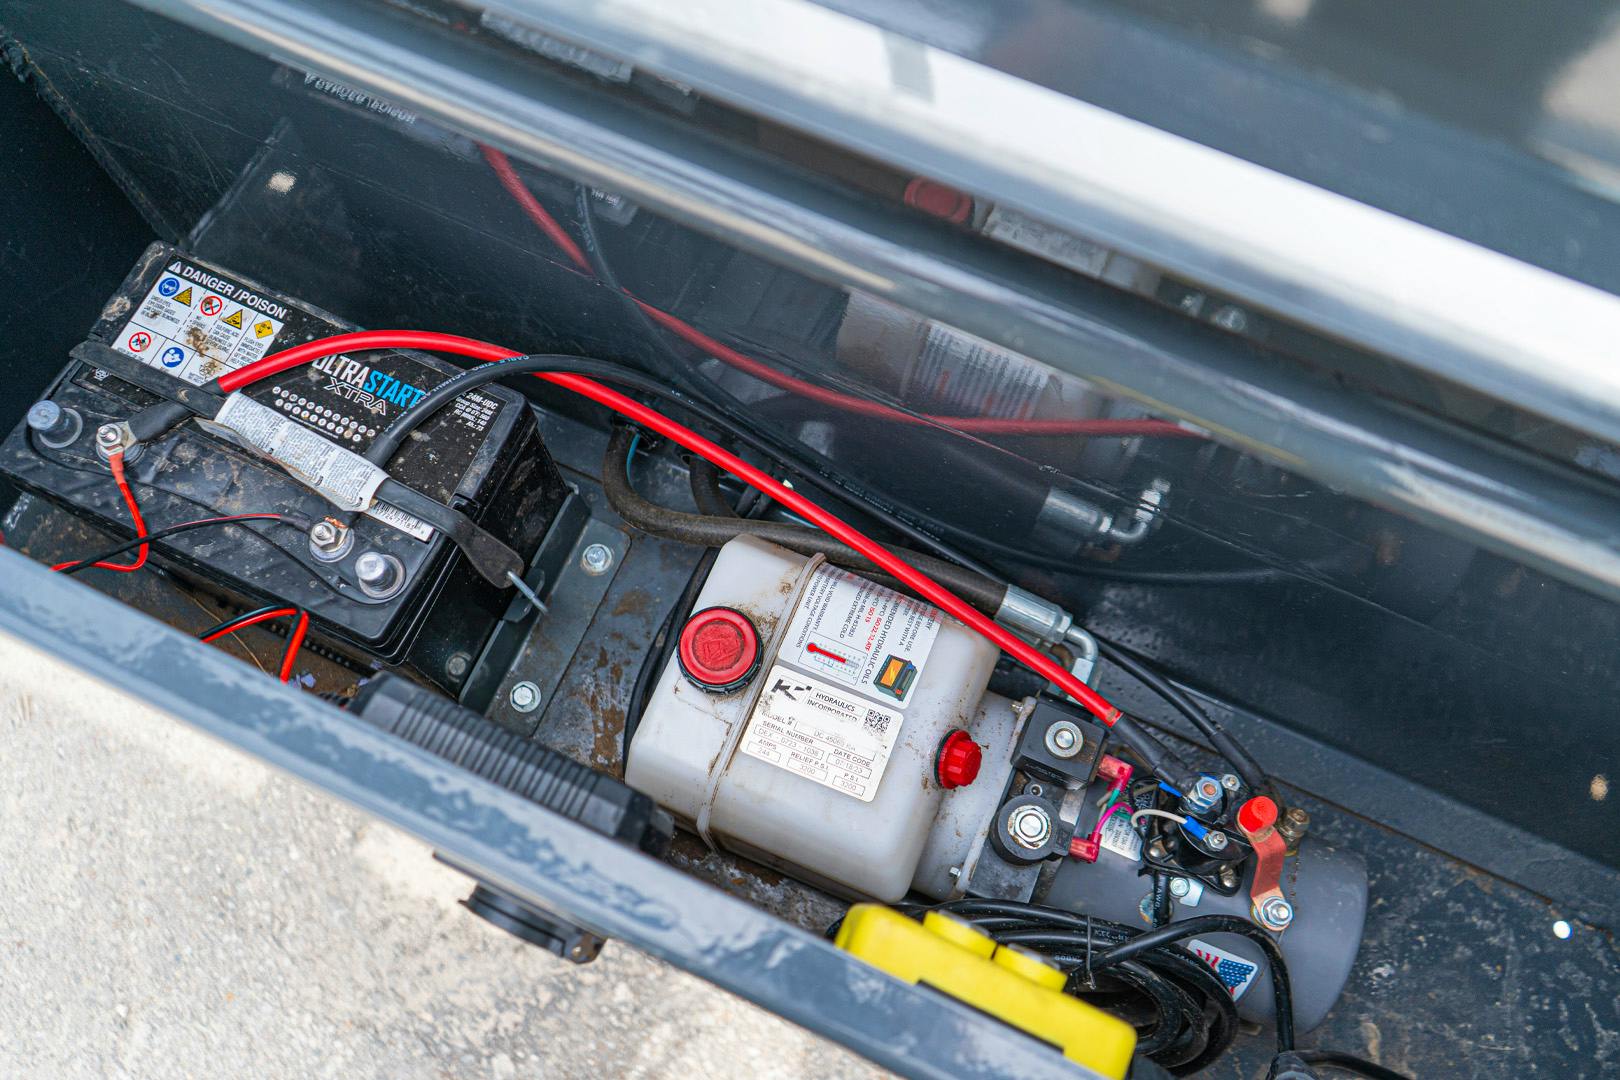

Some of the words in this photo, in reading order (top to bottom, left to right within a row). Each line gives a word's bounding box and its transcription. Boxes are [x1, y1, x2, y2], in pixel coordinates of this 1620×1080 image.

[181, 264, 235, 297] DANGER
[323, 375, 391, 415] XTRA
[808, 594, 822, 617] VOLTAGE
[795, 616, 813, 648] CONDITIONS
[864, 629, 890, 669] HYDRAULIC
[860, 668, 872, 684] OILS
[815, 691, 856, 713] HYDRAULICS
[761, 720, 785, 734] SERIAL
[785, 729, 813, 745] NUMBER
[790, 750, 813, 764] RELIEF
[832, 748, 851, 760] DATE
[851, 755, 871, 768] CODE
